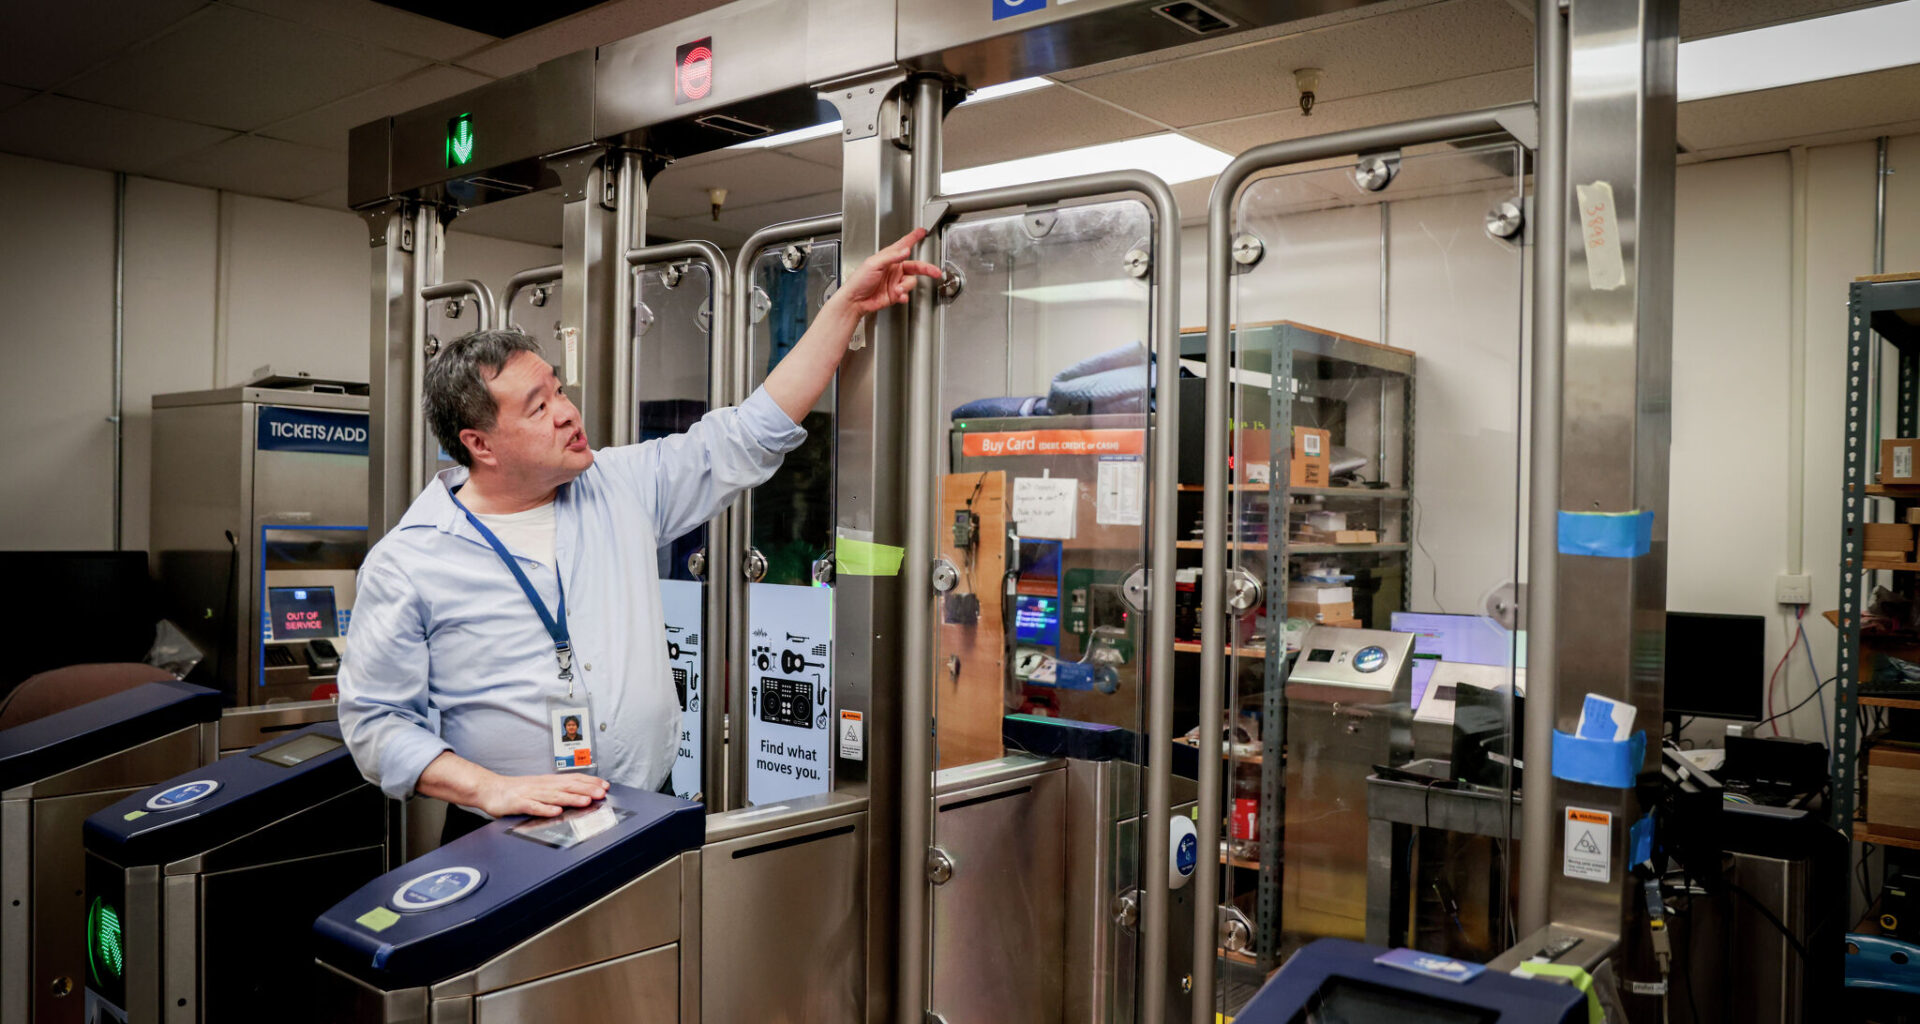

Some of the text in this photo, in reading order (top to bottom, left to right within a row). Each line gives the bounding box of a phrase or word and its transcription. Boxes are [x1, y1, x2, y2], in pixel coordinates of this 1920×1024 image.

[270, 422, 366, 441] TICKETS/ADD
[982, 438, 1004, 455] Buy
[1006, 436, 1035, 451] Card
[285, 621, 322, 630] SERVICE
[286, 611, 319, 621] OUT OF
[678, 747, 694, 759] ou.
[760, 739, 817, 762] Find what
[756, 759, 821, 780] moves you.
